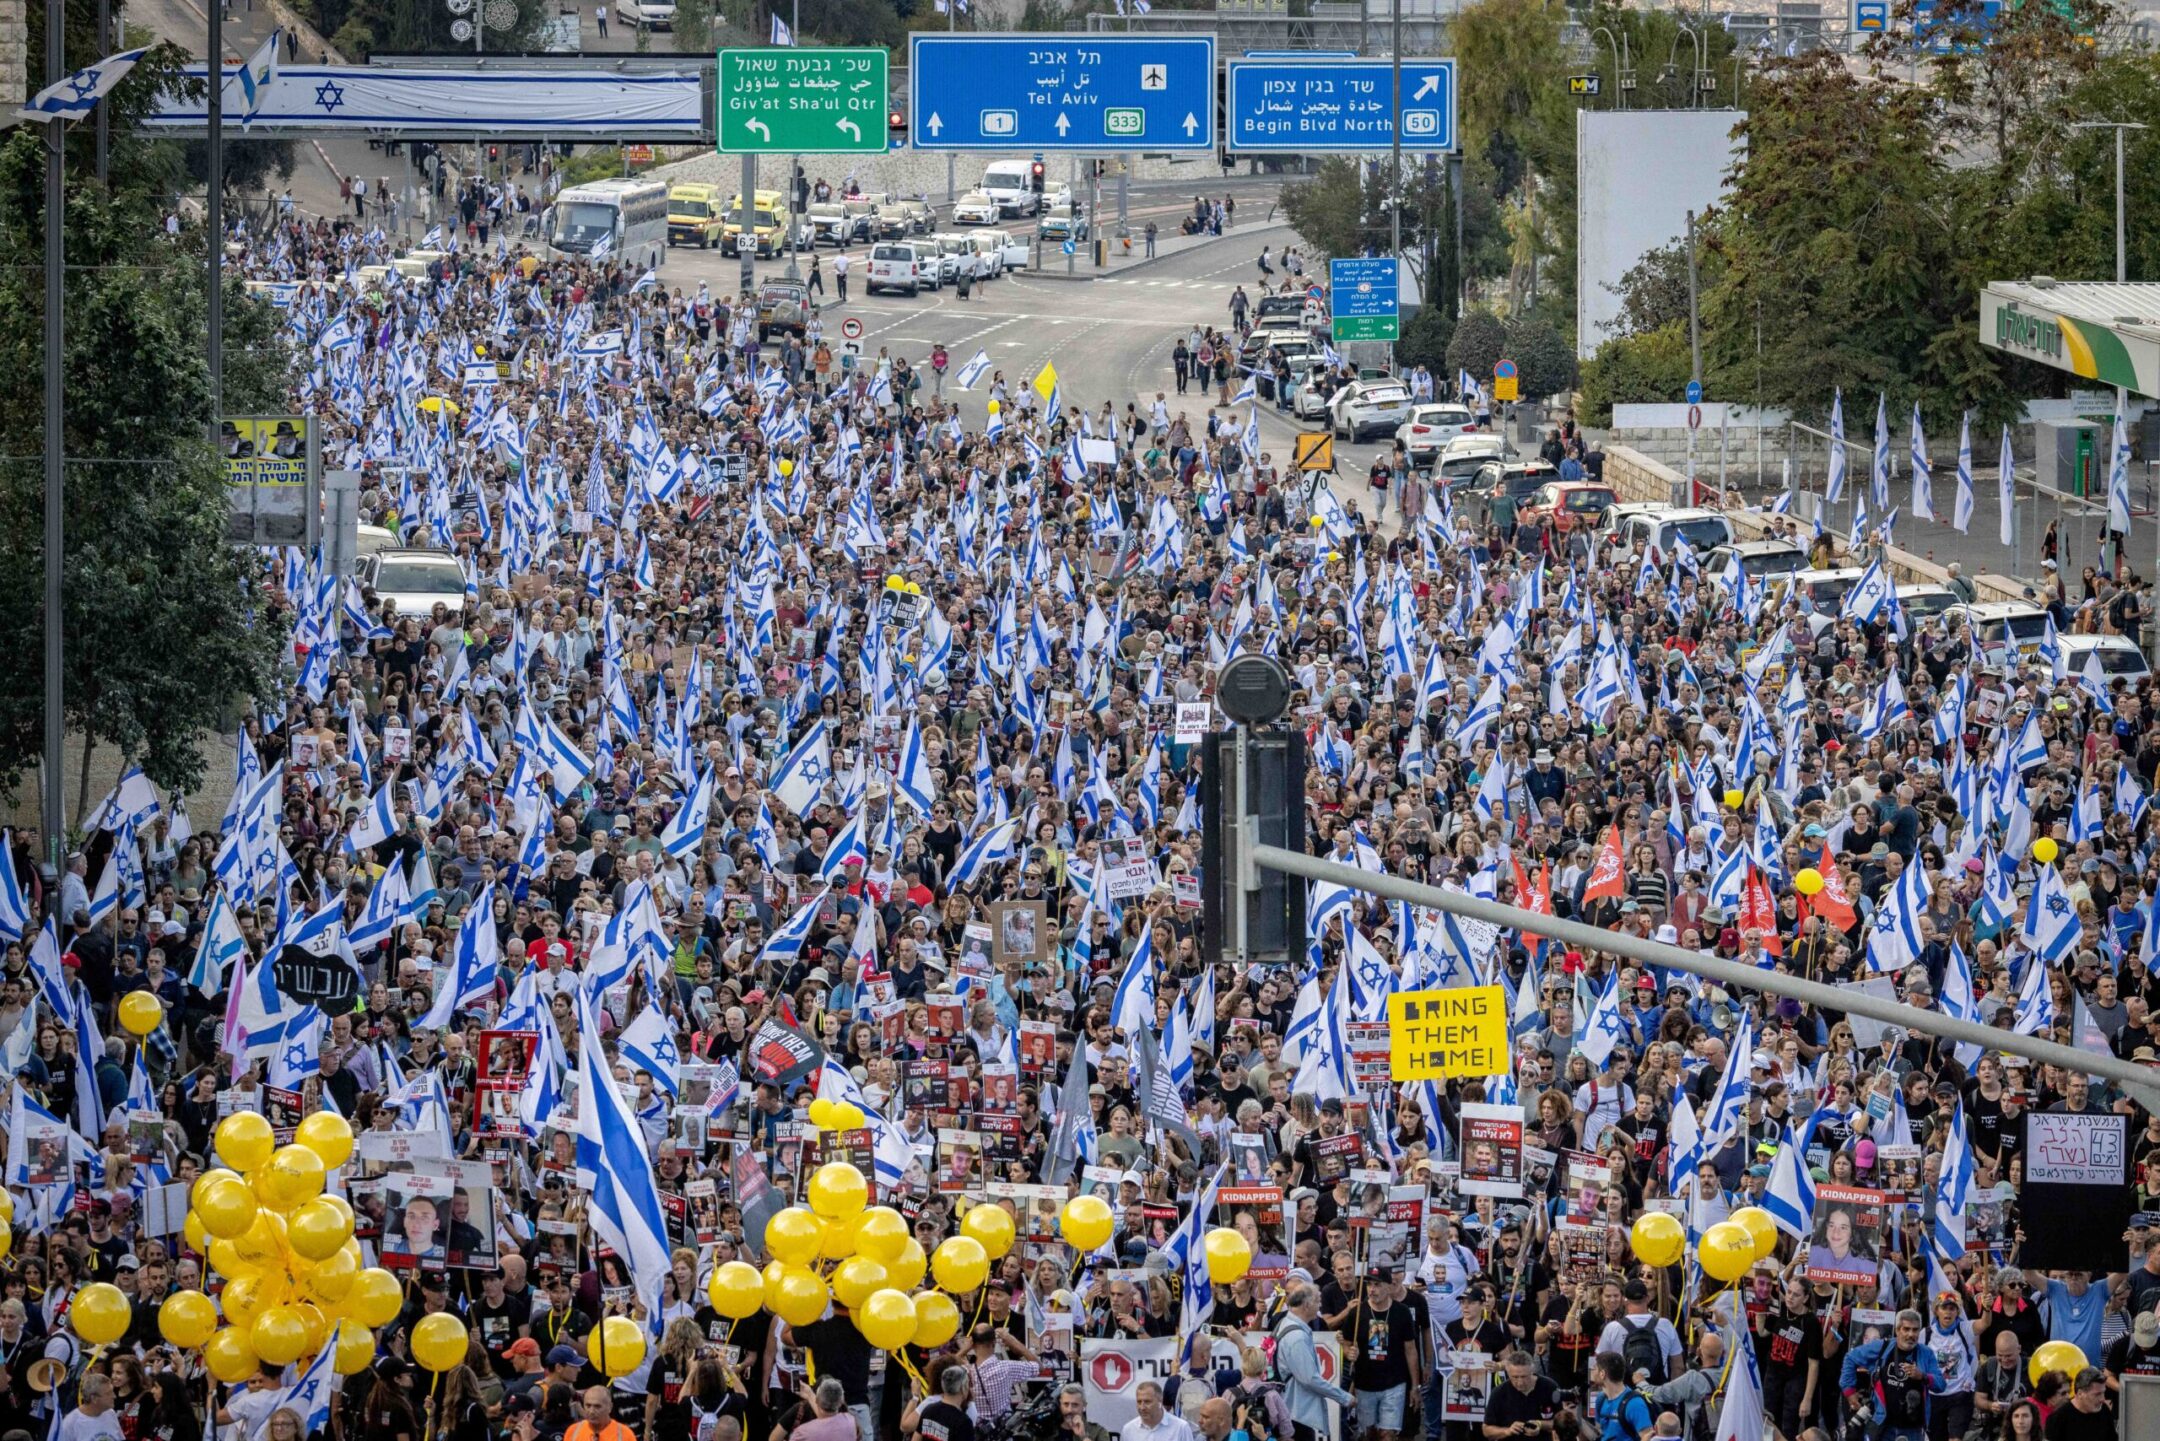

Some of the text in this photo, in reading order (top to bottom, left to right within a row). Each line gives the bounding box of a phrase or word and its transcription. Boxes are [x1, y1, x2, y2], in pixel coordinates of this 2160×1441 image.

[735, 56, 777, 71] שאול
[1028, 49, 1101, 65] תל אביב
[786, 58, 831, 73] גבעת
[1073, 73, 1090, 89] تل
[1263, 79, 1296, 97] צפון
[1305, 79, 1334, 96] בגין
[730, 97, 876, 111] Giv'at Sha'ul Qtr
[1027, 92, 1098, 105] Tel Aviv
[996, 117, 1002, 129] 1
[1111, 115, 1138, 128] 333
[1245, 118, 1393, 134] Begin Blvd North
[1411, 117, 1431, 128] 50
[739, 237, 756, 248] 6.2
[259, 462, 289, 472] המלך
[1126, 866, 1146, 878] אבא
[277, 962, 352, 999] עכשיו
[1405, 997, 1487, 1021] BRING
[1405, 1025, 1478, 1044] THEM
[778, 1033, 815, 1063] THEM
[1410, 1047, 1493, 1070] HOME!
[1147, 1070, 1172, 1117] BRING
[2033, 1114, 2120, 1127] ממשלת ישראל
[1471, 1129, 1513, 1140] לא איתנו
[2043, 1126, 2084, 1144] הלב
[1342, 1142, 1353, 1151] לא
[2092, 1132, 2118, 1154] 43
[2039, 1145, 2087, 1166] נשרף
[2093, 1153, 2119, 1164] ימים
[2061, 1168, 2084, 1180] עדיין
[1222, 1192, 1279, 1201] KIDNAPPED
[1820, 1189, 1880, 1203] KIDNAPPED
[1810, 1268, 1873, 1283] גלי חטופה בעזה
